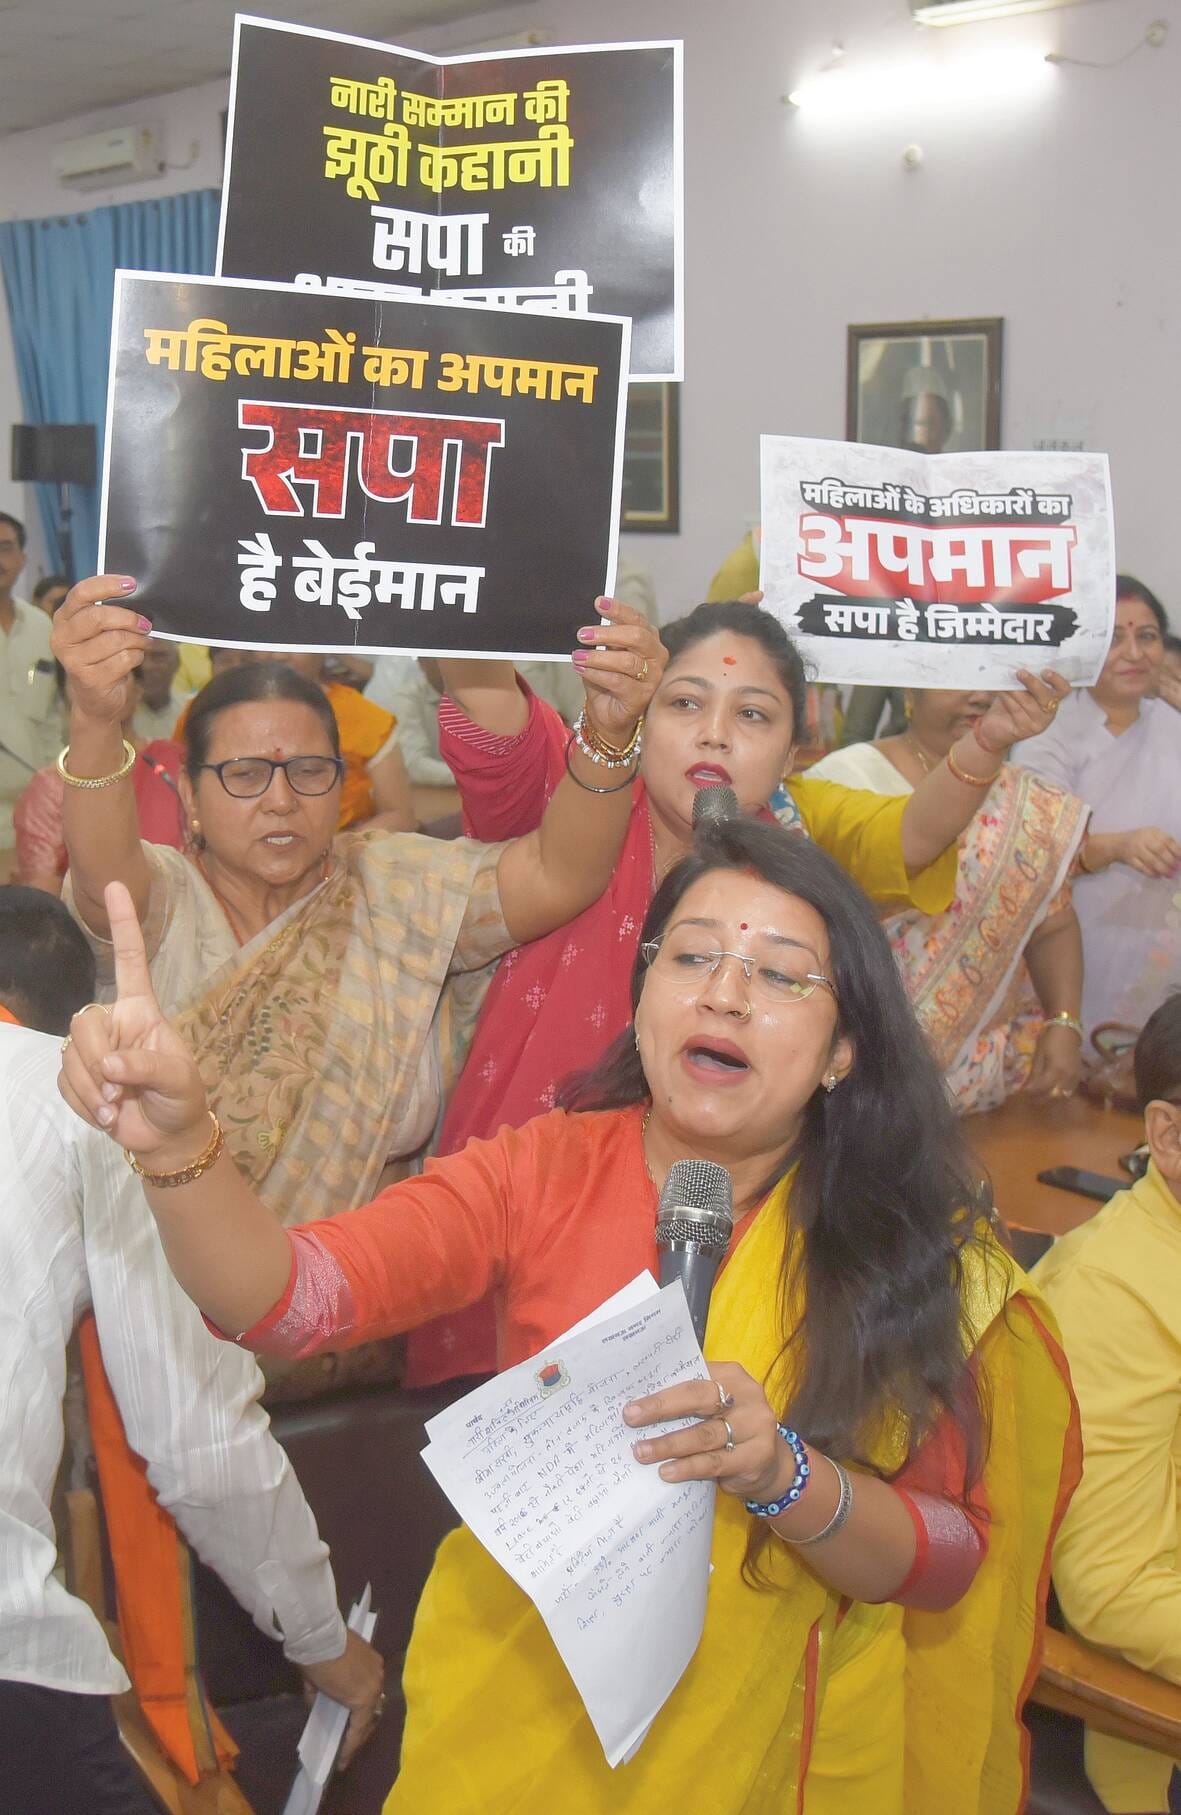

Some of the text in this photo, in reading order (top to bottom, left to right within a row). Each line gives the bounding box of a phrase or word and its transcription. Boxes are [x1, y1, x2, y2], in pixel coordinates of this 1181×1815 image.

[329, 76, 570, 129] नारी सम्मान की
[323, 123, 574, 202] झूठी कहानी
[370, 205, 536, 277] सपा की
[143, 318, 599, 404] महिलाओं का अपमान
[237, 399, 506, 529] सपा
[801, 478, 1073, 518] महिलाओं के अधिकारों का
[237, 532, 487, 620] है बेईमान
[799, 514, 1076, 590] अपमान
[822, 598, 1055, 643] सपा है जिम्मेदार
